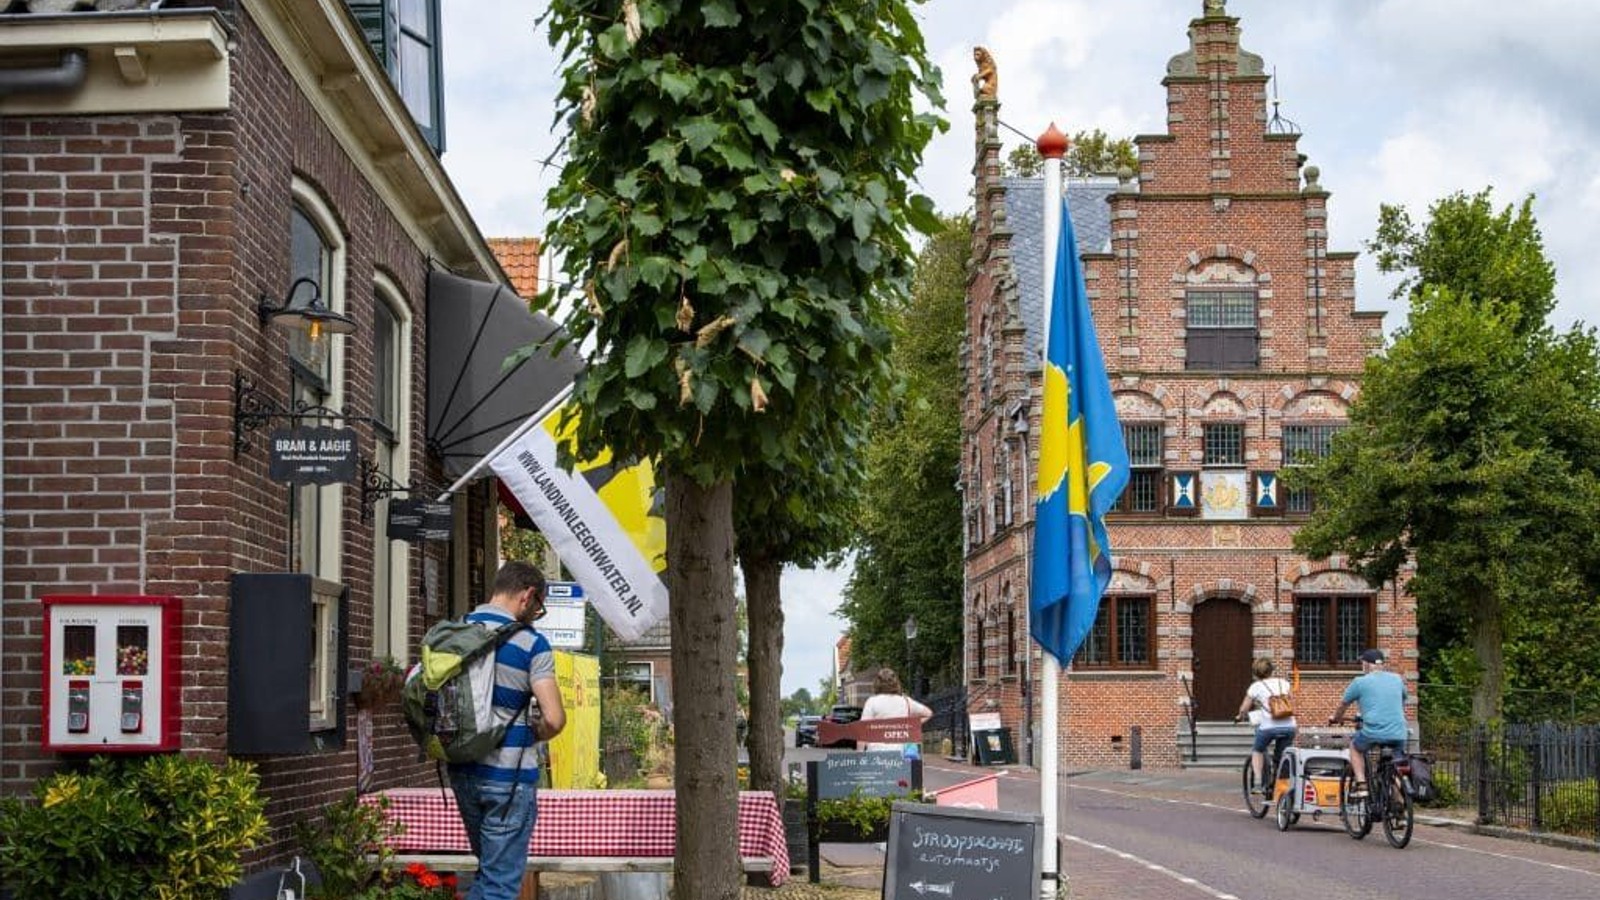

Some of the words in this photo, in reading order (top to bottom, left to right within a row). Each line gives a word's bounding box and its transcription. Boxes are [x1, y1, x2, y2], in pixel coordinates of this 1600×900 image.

[276, 439, 306, 452] BRAM
[309, 440, 317, 452] &
[320, 439, 352, 452] AAGIE
[517, 450, 644, 618] WWW.LANDVANLEEGHWATER.NL
[884, 730, 909, 739] OPEN
[859, 757, 867, 765] &
